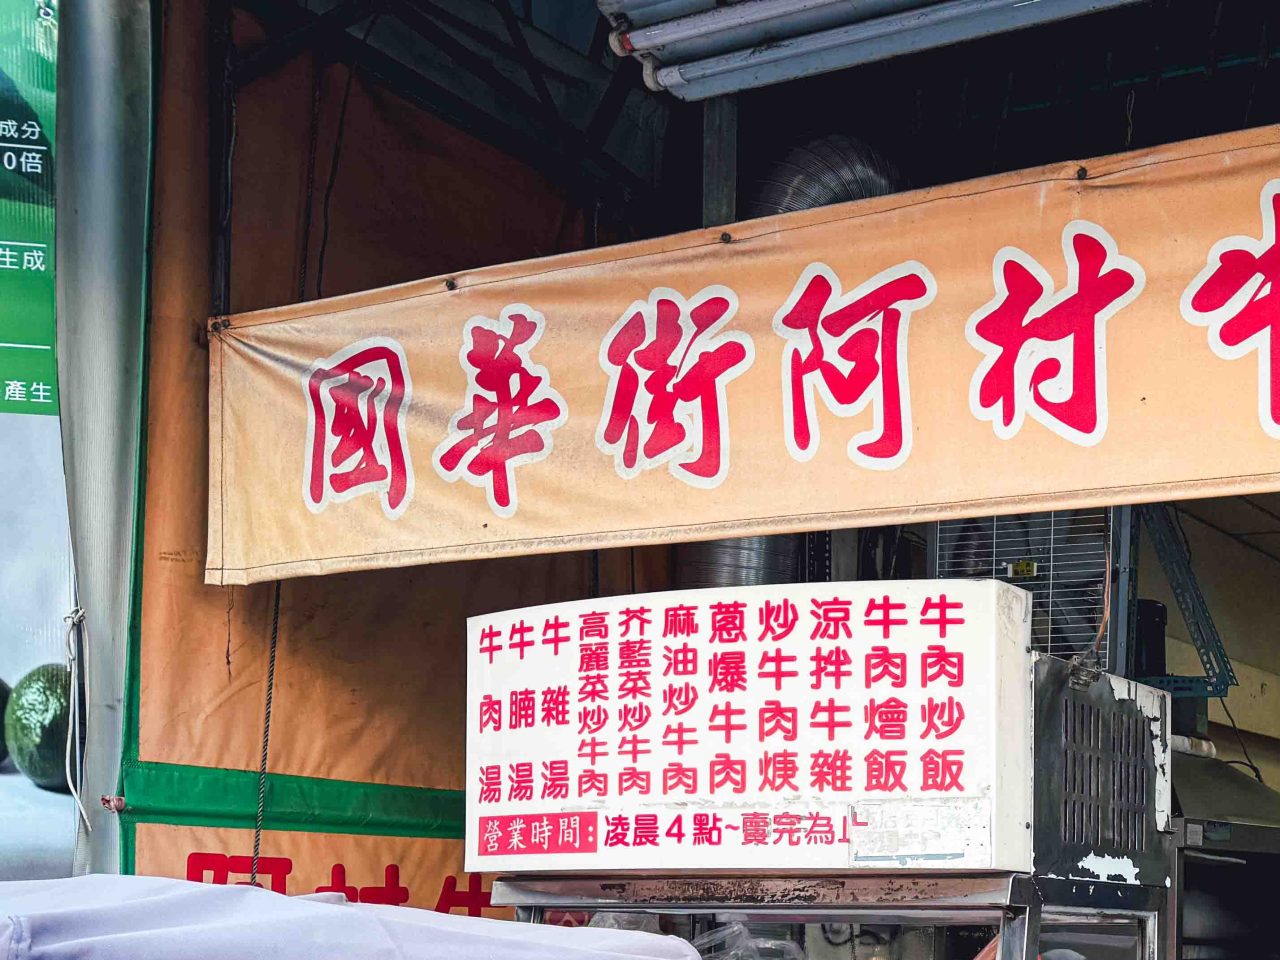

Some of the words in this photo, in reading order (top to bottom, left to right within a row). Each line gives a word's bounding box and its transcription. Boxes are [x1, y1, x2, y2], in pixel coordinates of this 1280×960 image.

[0, 119, 41, 139] 成分
[0, 247, 45, 271] 生成
[4, 380, 53, 402] 產生
[479, 624, 503, 804] 牛肉湯
[508, 620, 535, 802] 牛腩湯
[540, 615, 570, 801] 牛雜湯
[577, 611, 609, 797] 高麗菜炒牛肉
[617, 606, 652, 796] 芥藍菜炒牛肉
[662, 604, 699, 795] 麻油炒牛肉
[809, 597, 852, 791] 涼拌牛雜
[864, 595, 908, 791] 牛肉燴飯
[919, 594, 965, 791] 牛肉炒飯
